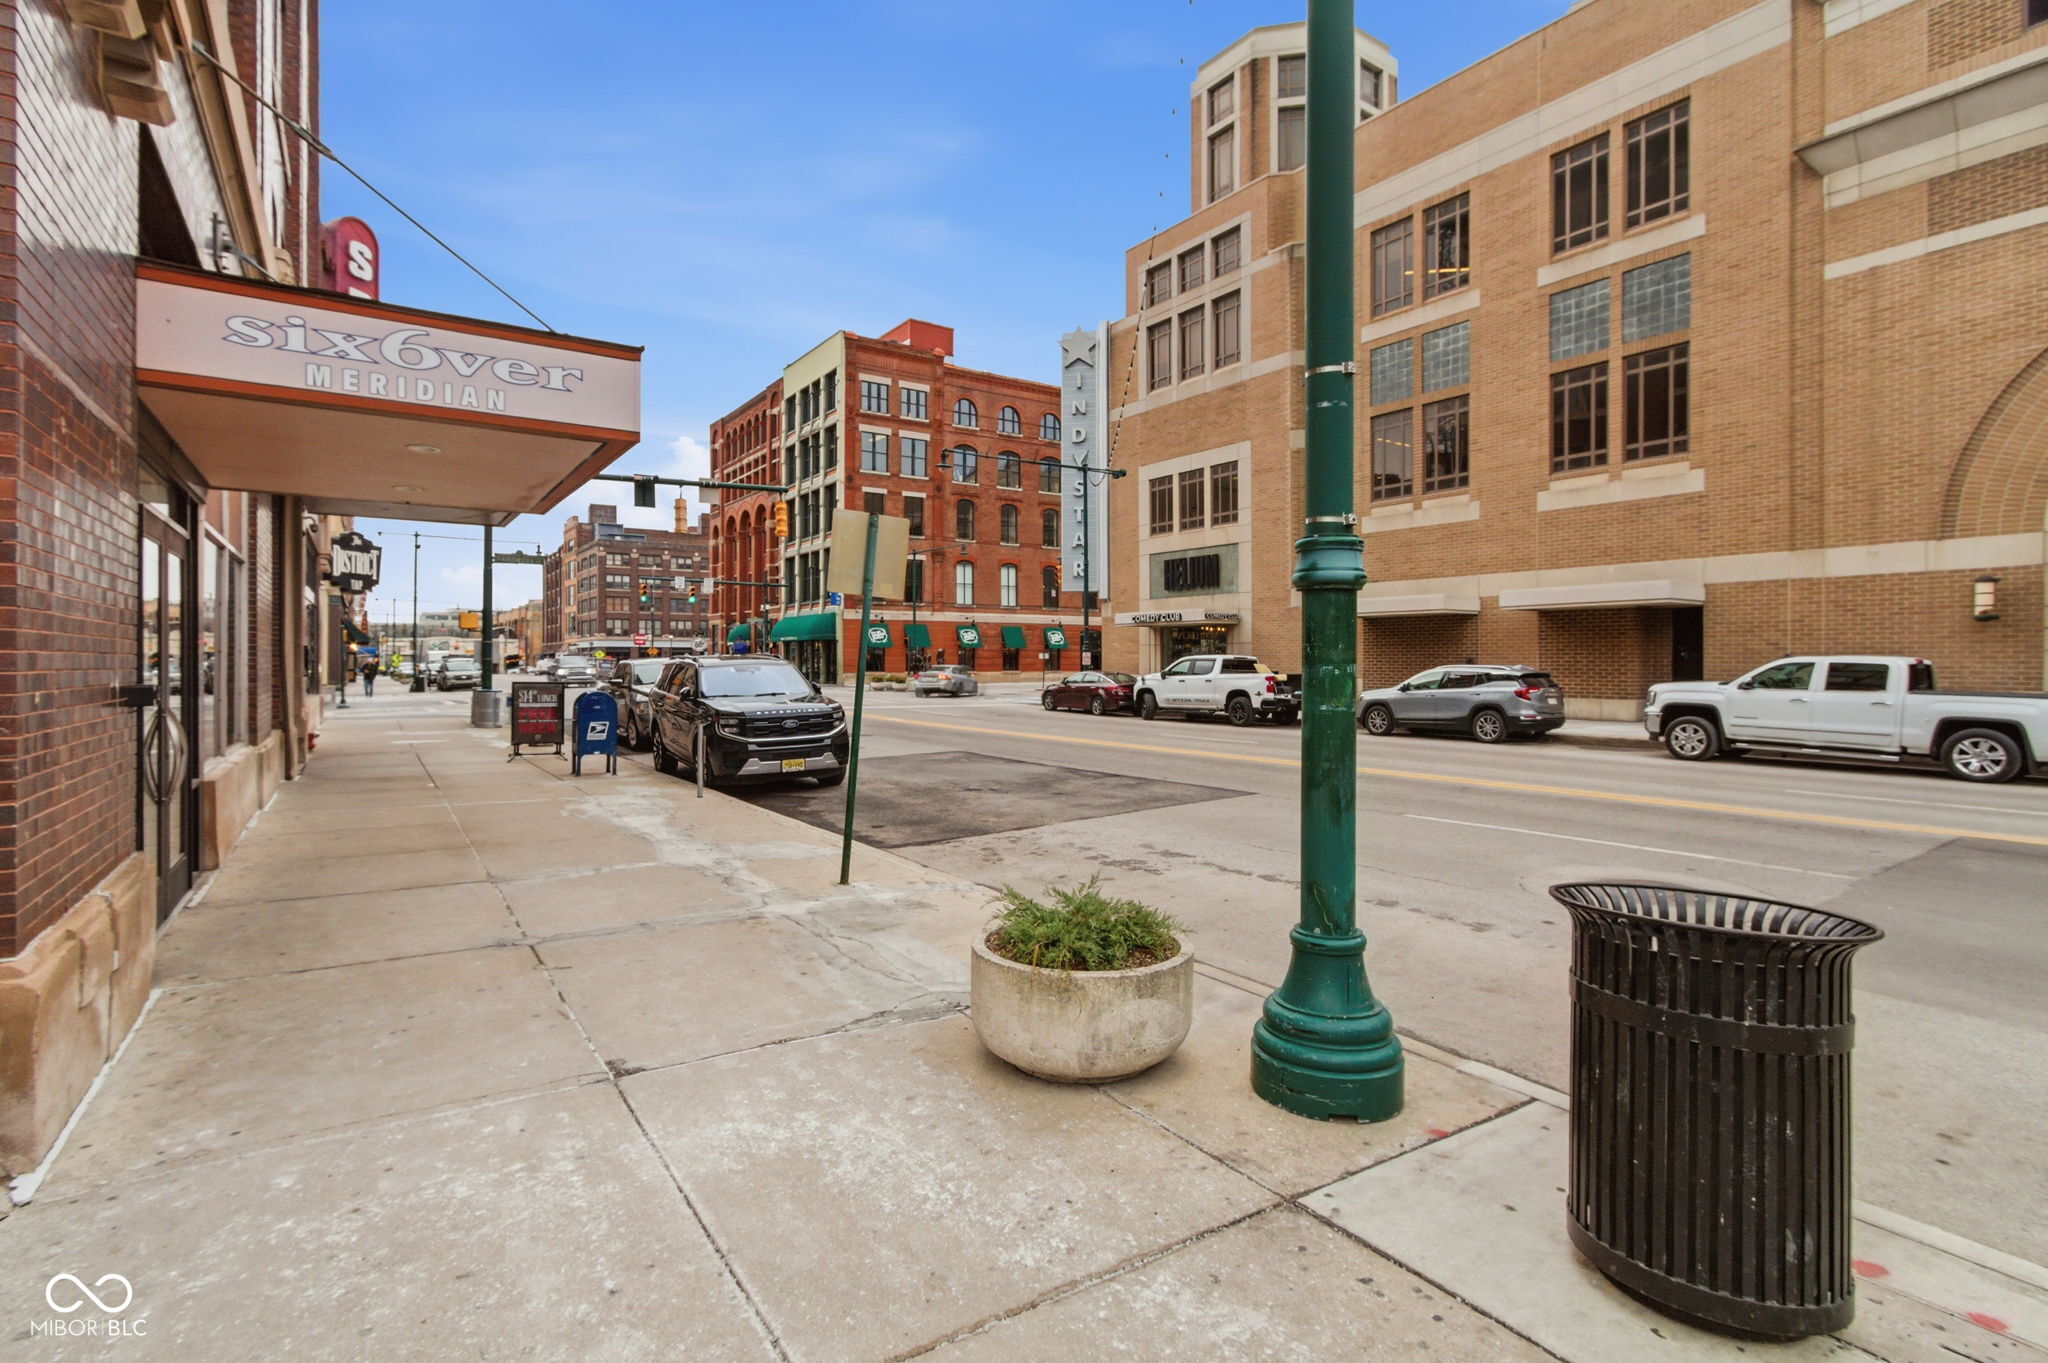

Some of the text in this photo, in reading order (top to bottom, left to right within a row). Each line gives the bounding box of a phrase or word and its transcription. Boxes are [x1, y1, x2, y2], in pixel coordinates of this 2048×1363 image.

[305, 362, 506, 411] MERIDIAN
[332, 544, 380, 580] DISTRICT
[1163, 553, 1220, 593] HELIUM
[350, 579, 363, 590] TAP
[1132, 612, 1182, 623] COMEDY CLUB
[1205, 612, 1227, 620] COMEDY
